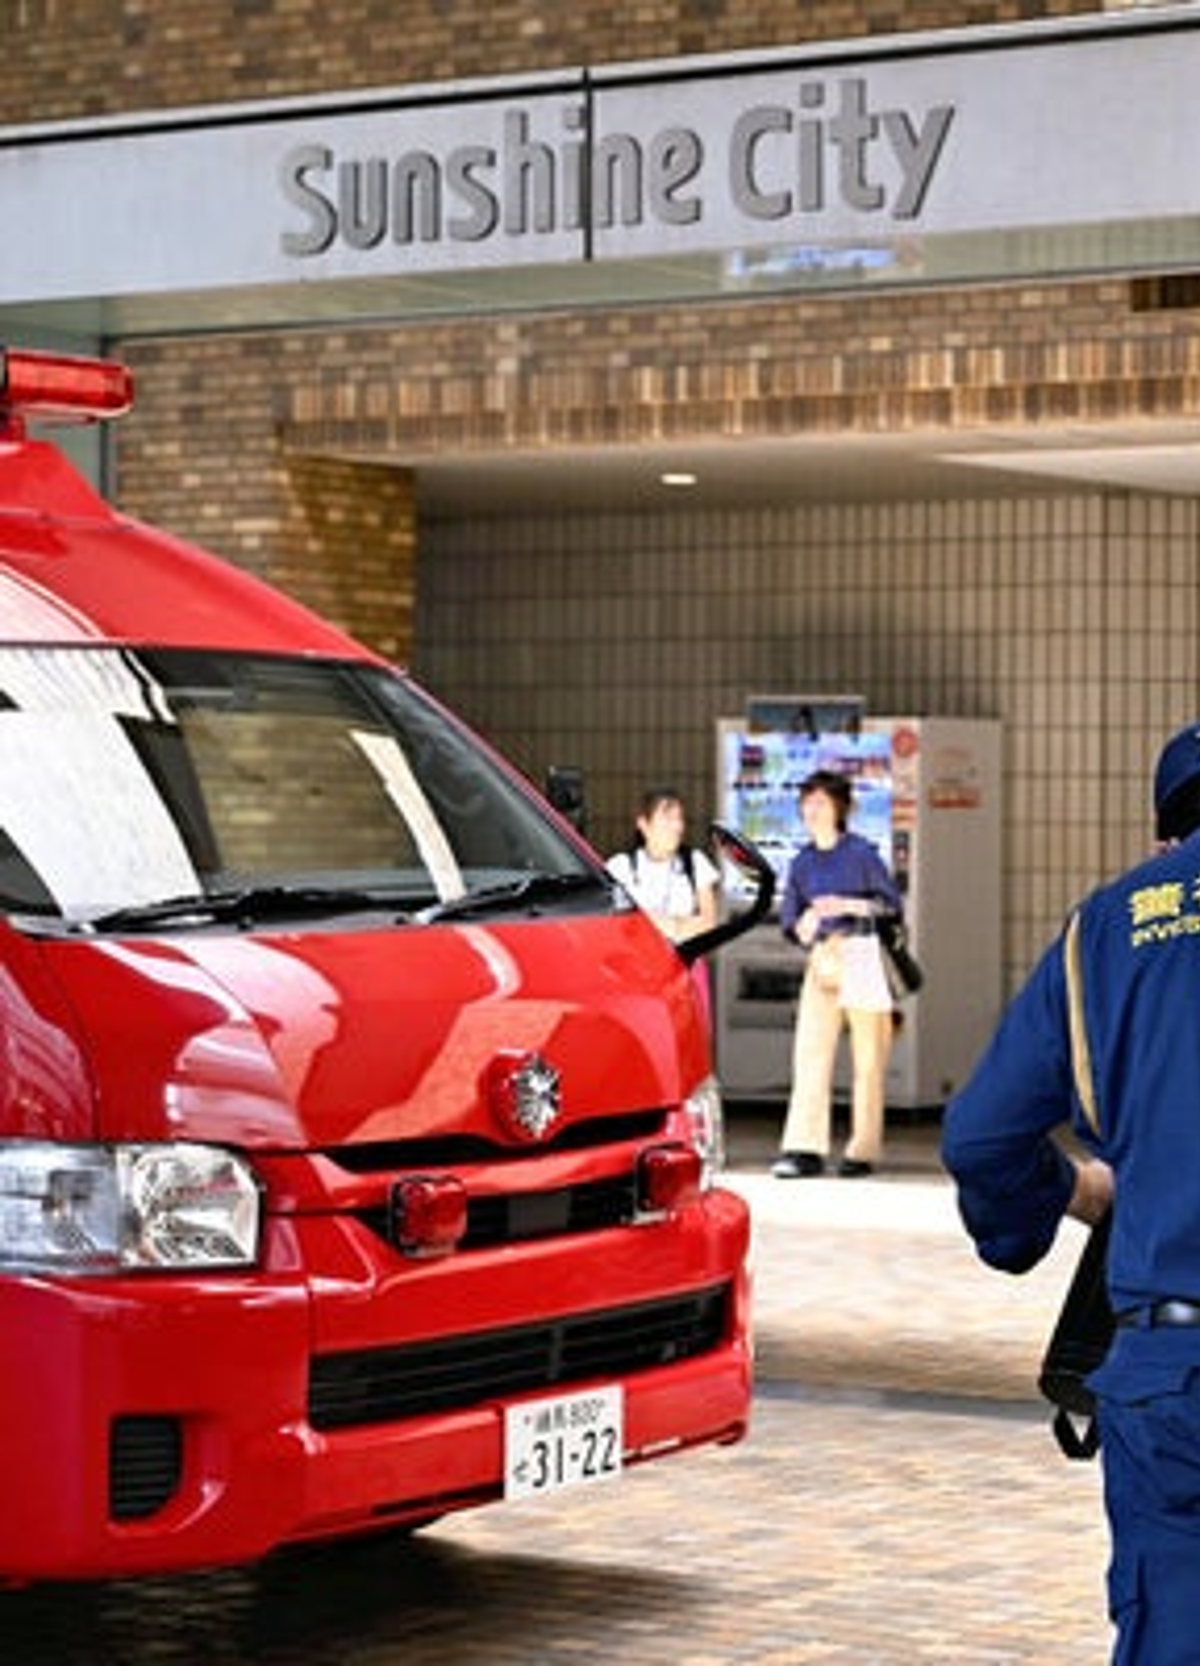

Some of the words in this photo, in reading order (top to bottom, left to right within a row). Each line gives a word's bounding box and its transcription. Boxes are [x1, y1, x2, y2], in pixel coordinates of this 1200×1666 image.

[280, 105, 702, 259] Sunshine
[727, 78, 956, 221] City
[532, 1426, 616, 1488] 31-22
